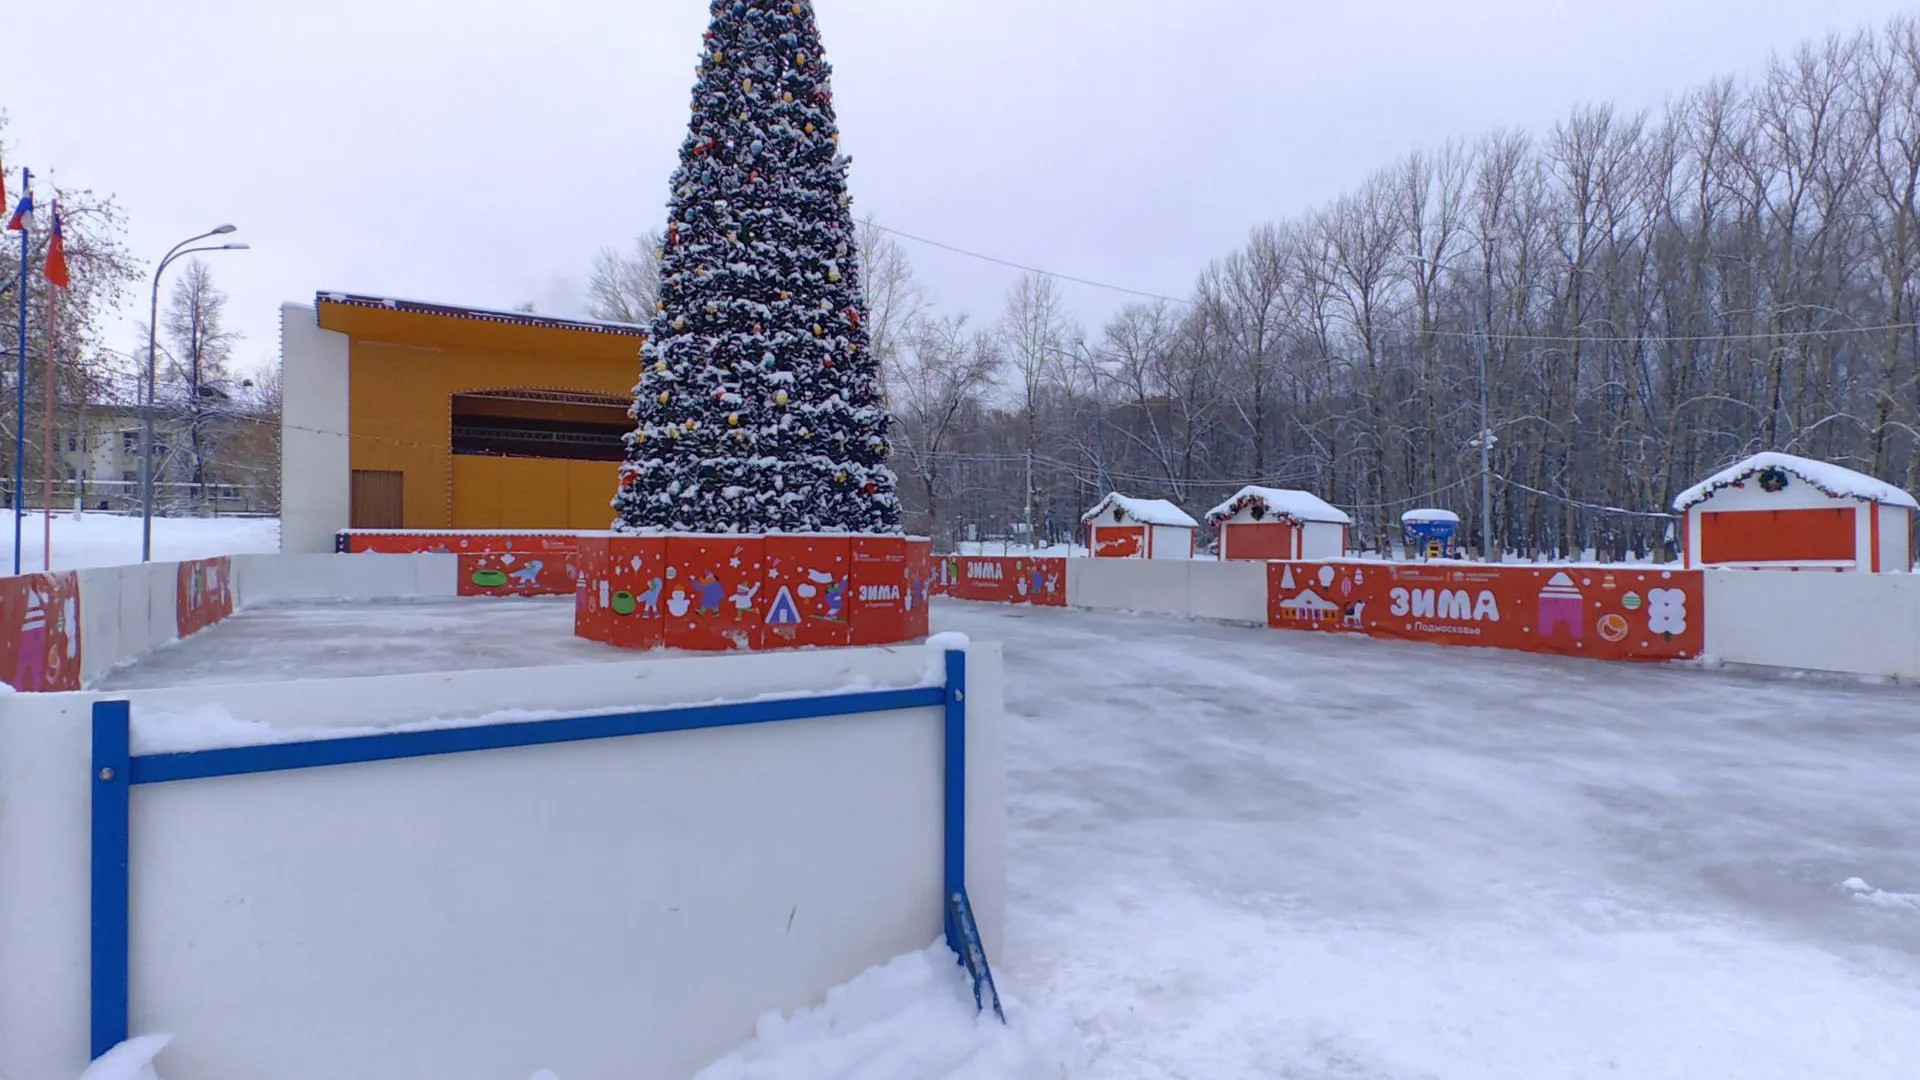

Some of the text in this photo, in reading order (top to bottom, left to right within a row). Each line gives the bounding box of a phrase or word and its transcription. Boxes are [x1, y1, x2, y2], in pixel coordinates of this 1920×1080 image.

[967, 561, 1003, 580] ЗИМА
[859, 585, 900, 601] ЗИМА
[1390, 587, 1500, 622] ЗИМА
[1415, 621, 1481, 635] Подмосковье
